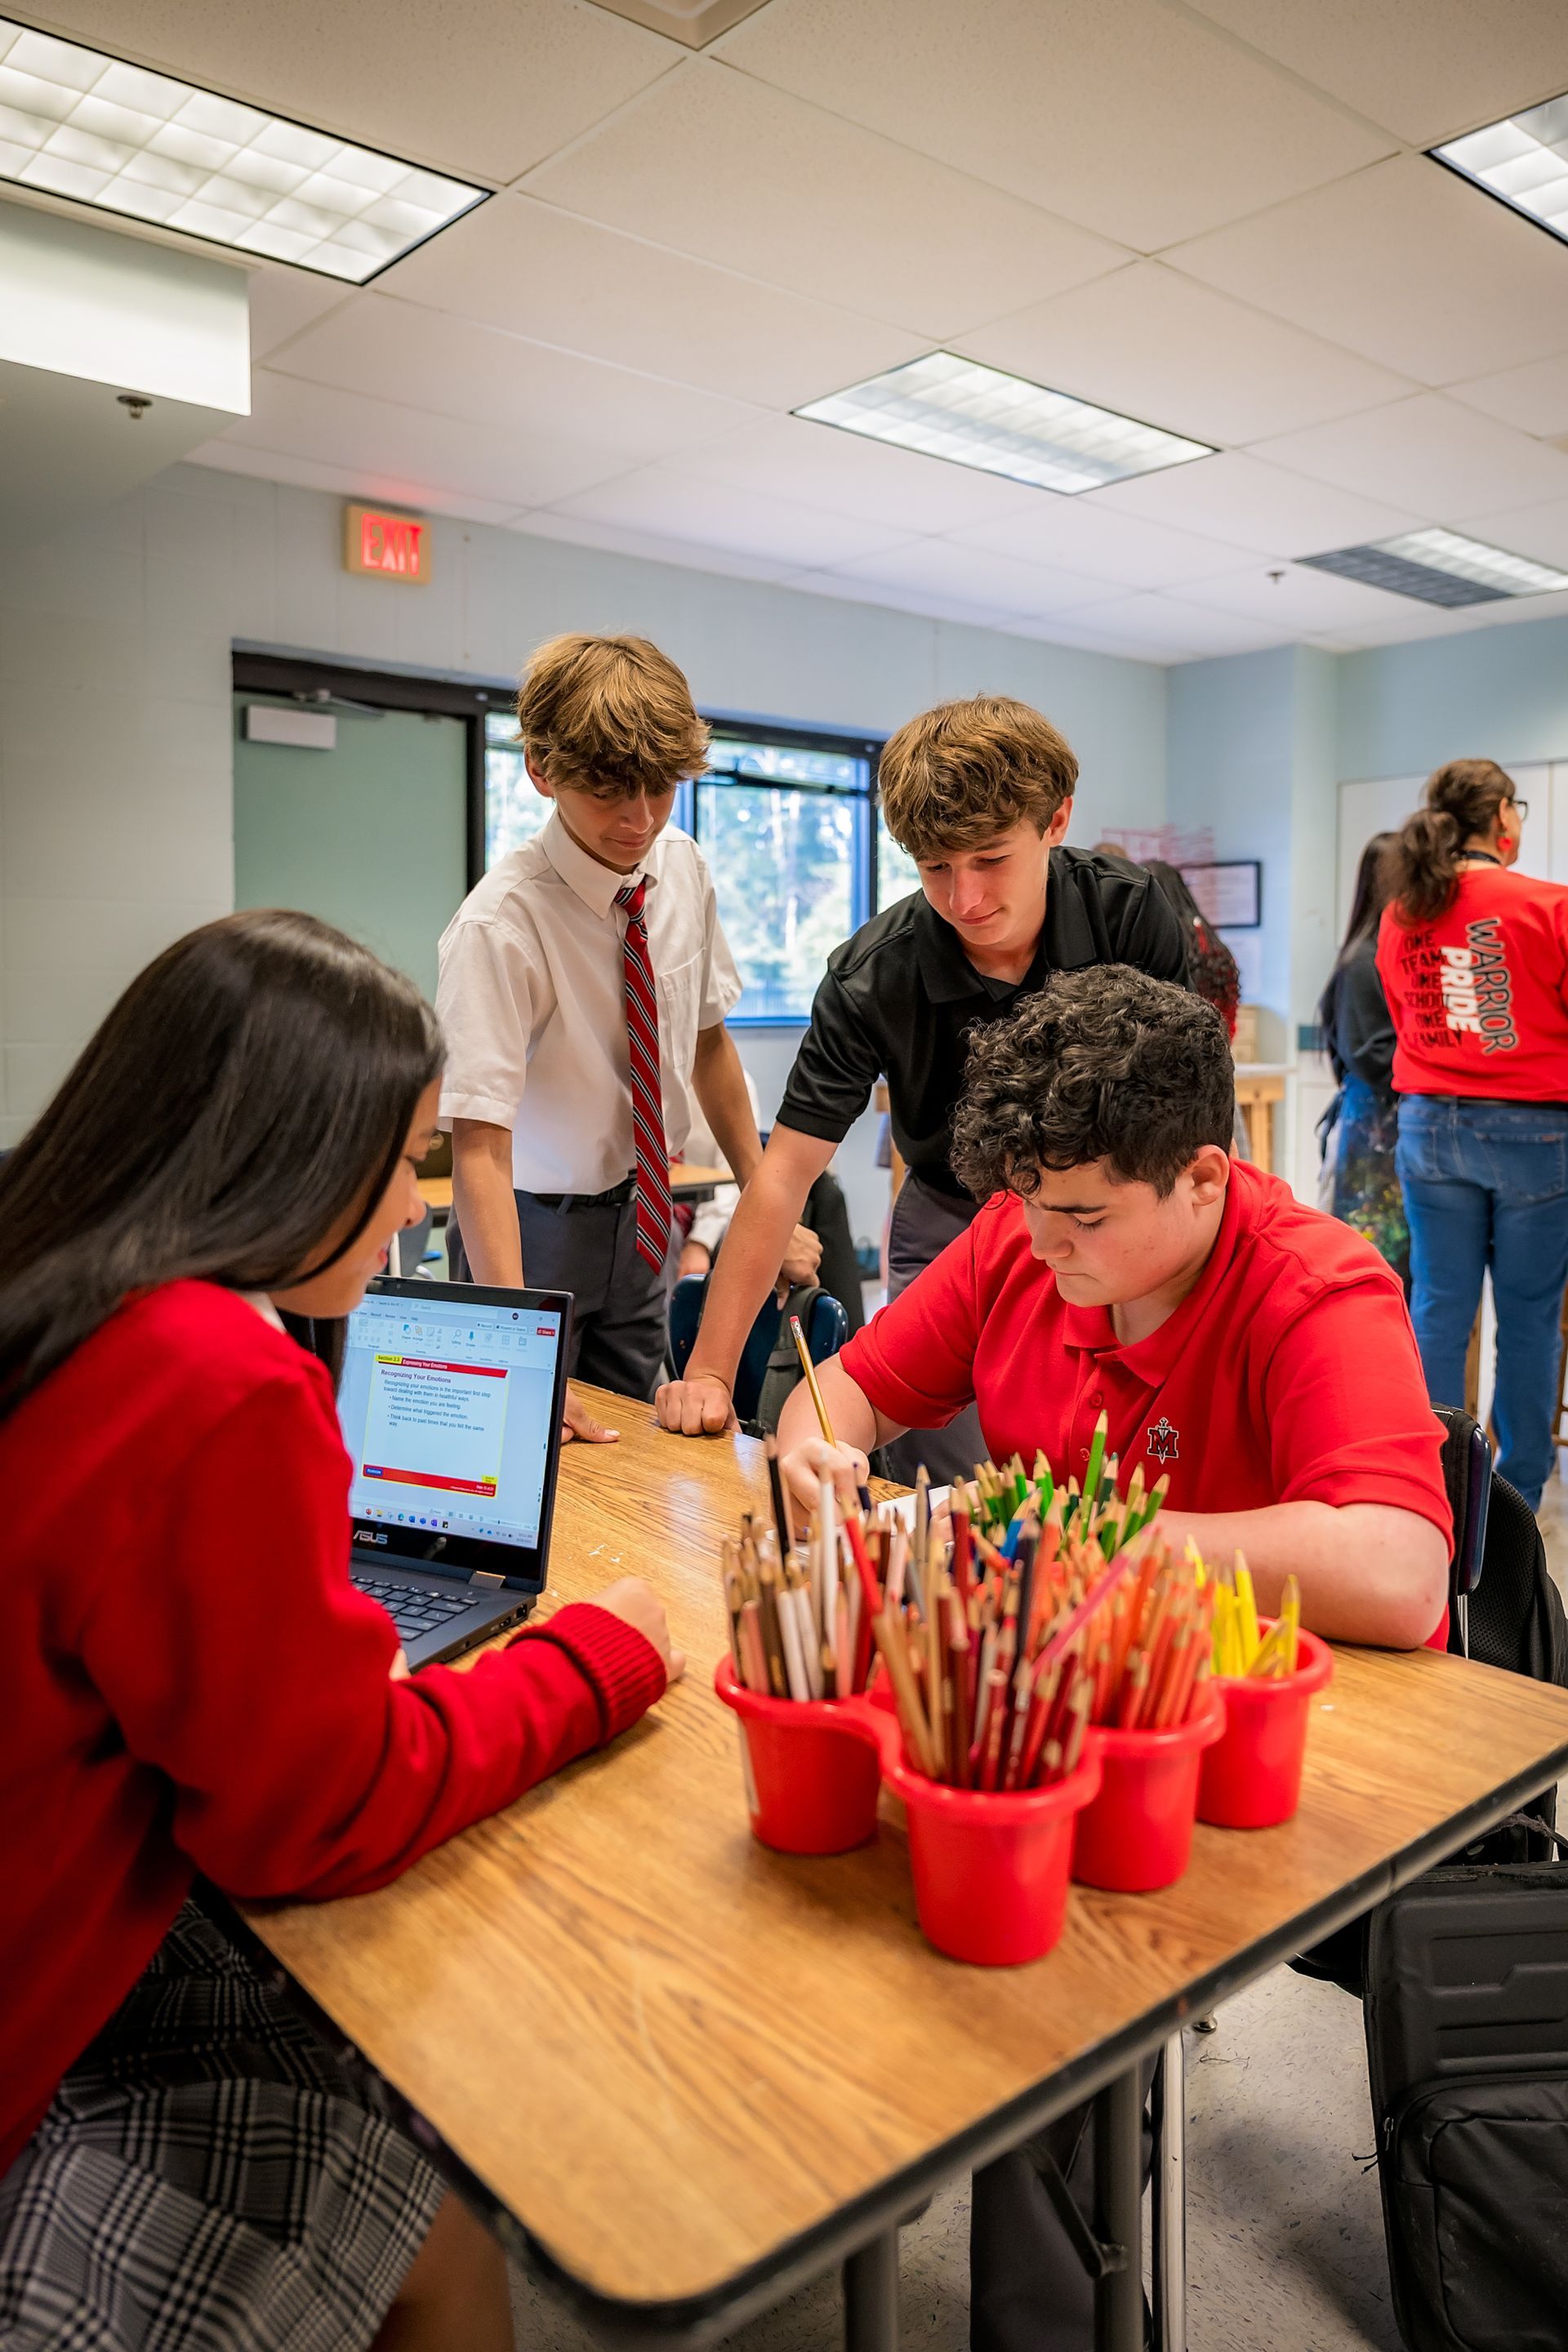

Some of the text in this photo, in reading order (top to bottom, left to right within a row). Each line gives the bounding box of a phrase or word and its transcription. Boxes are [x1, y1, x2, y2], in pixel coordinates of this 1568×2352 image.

[361, 514, 423, 575] EXIT
[1404, 930, 1434, 951] ONE
[1401, 947, 1446, 974] TEAM
[1440, 946, 1483, 1033] PRIDE
[1465, 916, 1518, 1054] WARRIOR
[403, 1359, 422, 1367] Expressing
[381, 1370, 412, 1379] Recognizing
[426, 1374, 452, 1383] Emotions
[384, 1379, 409, 1388] Recognizing
[452, 1388, 472, 1396] important
[423, 1408, 442, 1416] triggered
[353, 1530, 388, 1545] ASUS
